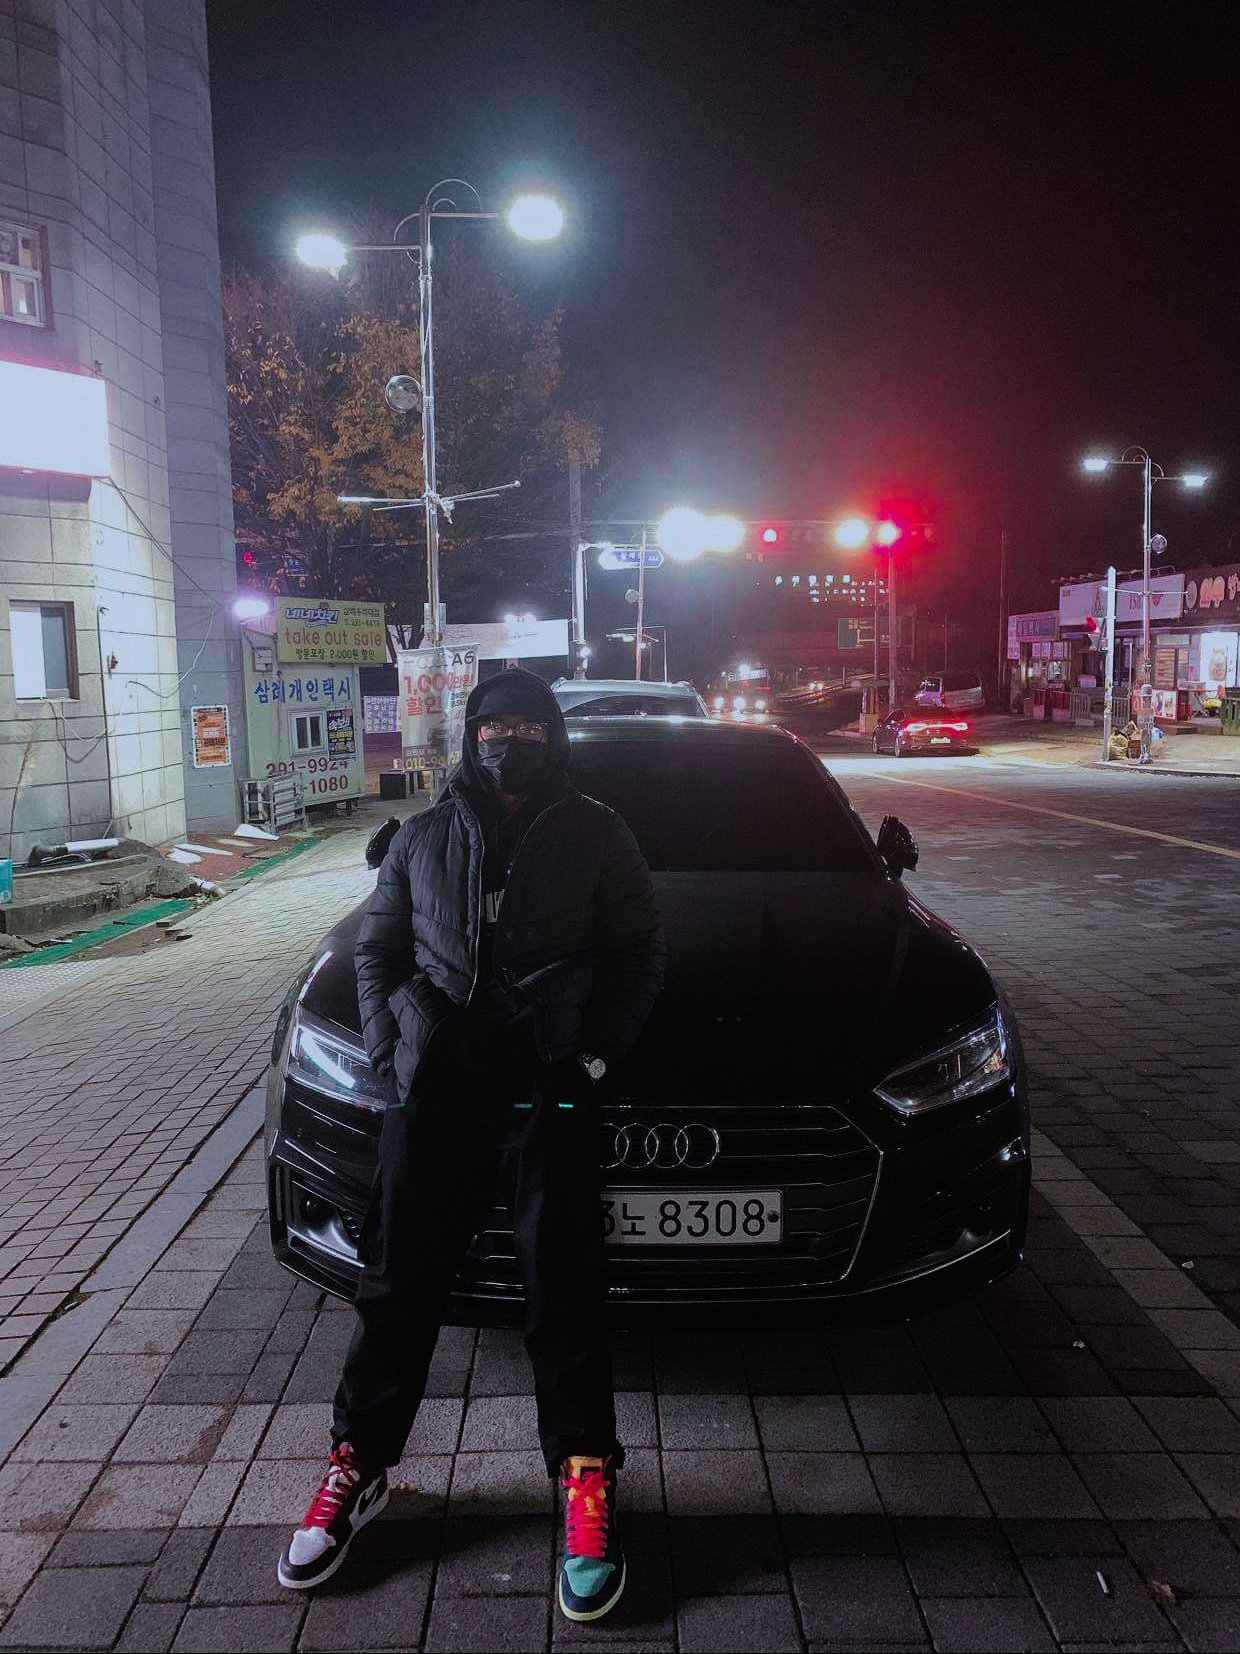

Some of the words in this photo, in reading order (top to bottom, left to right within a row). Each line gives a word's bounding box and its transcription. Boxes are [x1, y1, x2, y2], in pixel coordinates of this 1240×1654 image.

[284, 628, 320, 645] take
[324, 630, 349, 646] out
[353, 630, 382, 647] sale
[452, 650, 474, 666] A6
[658, 1199, 765, 1237] 8308
